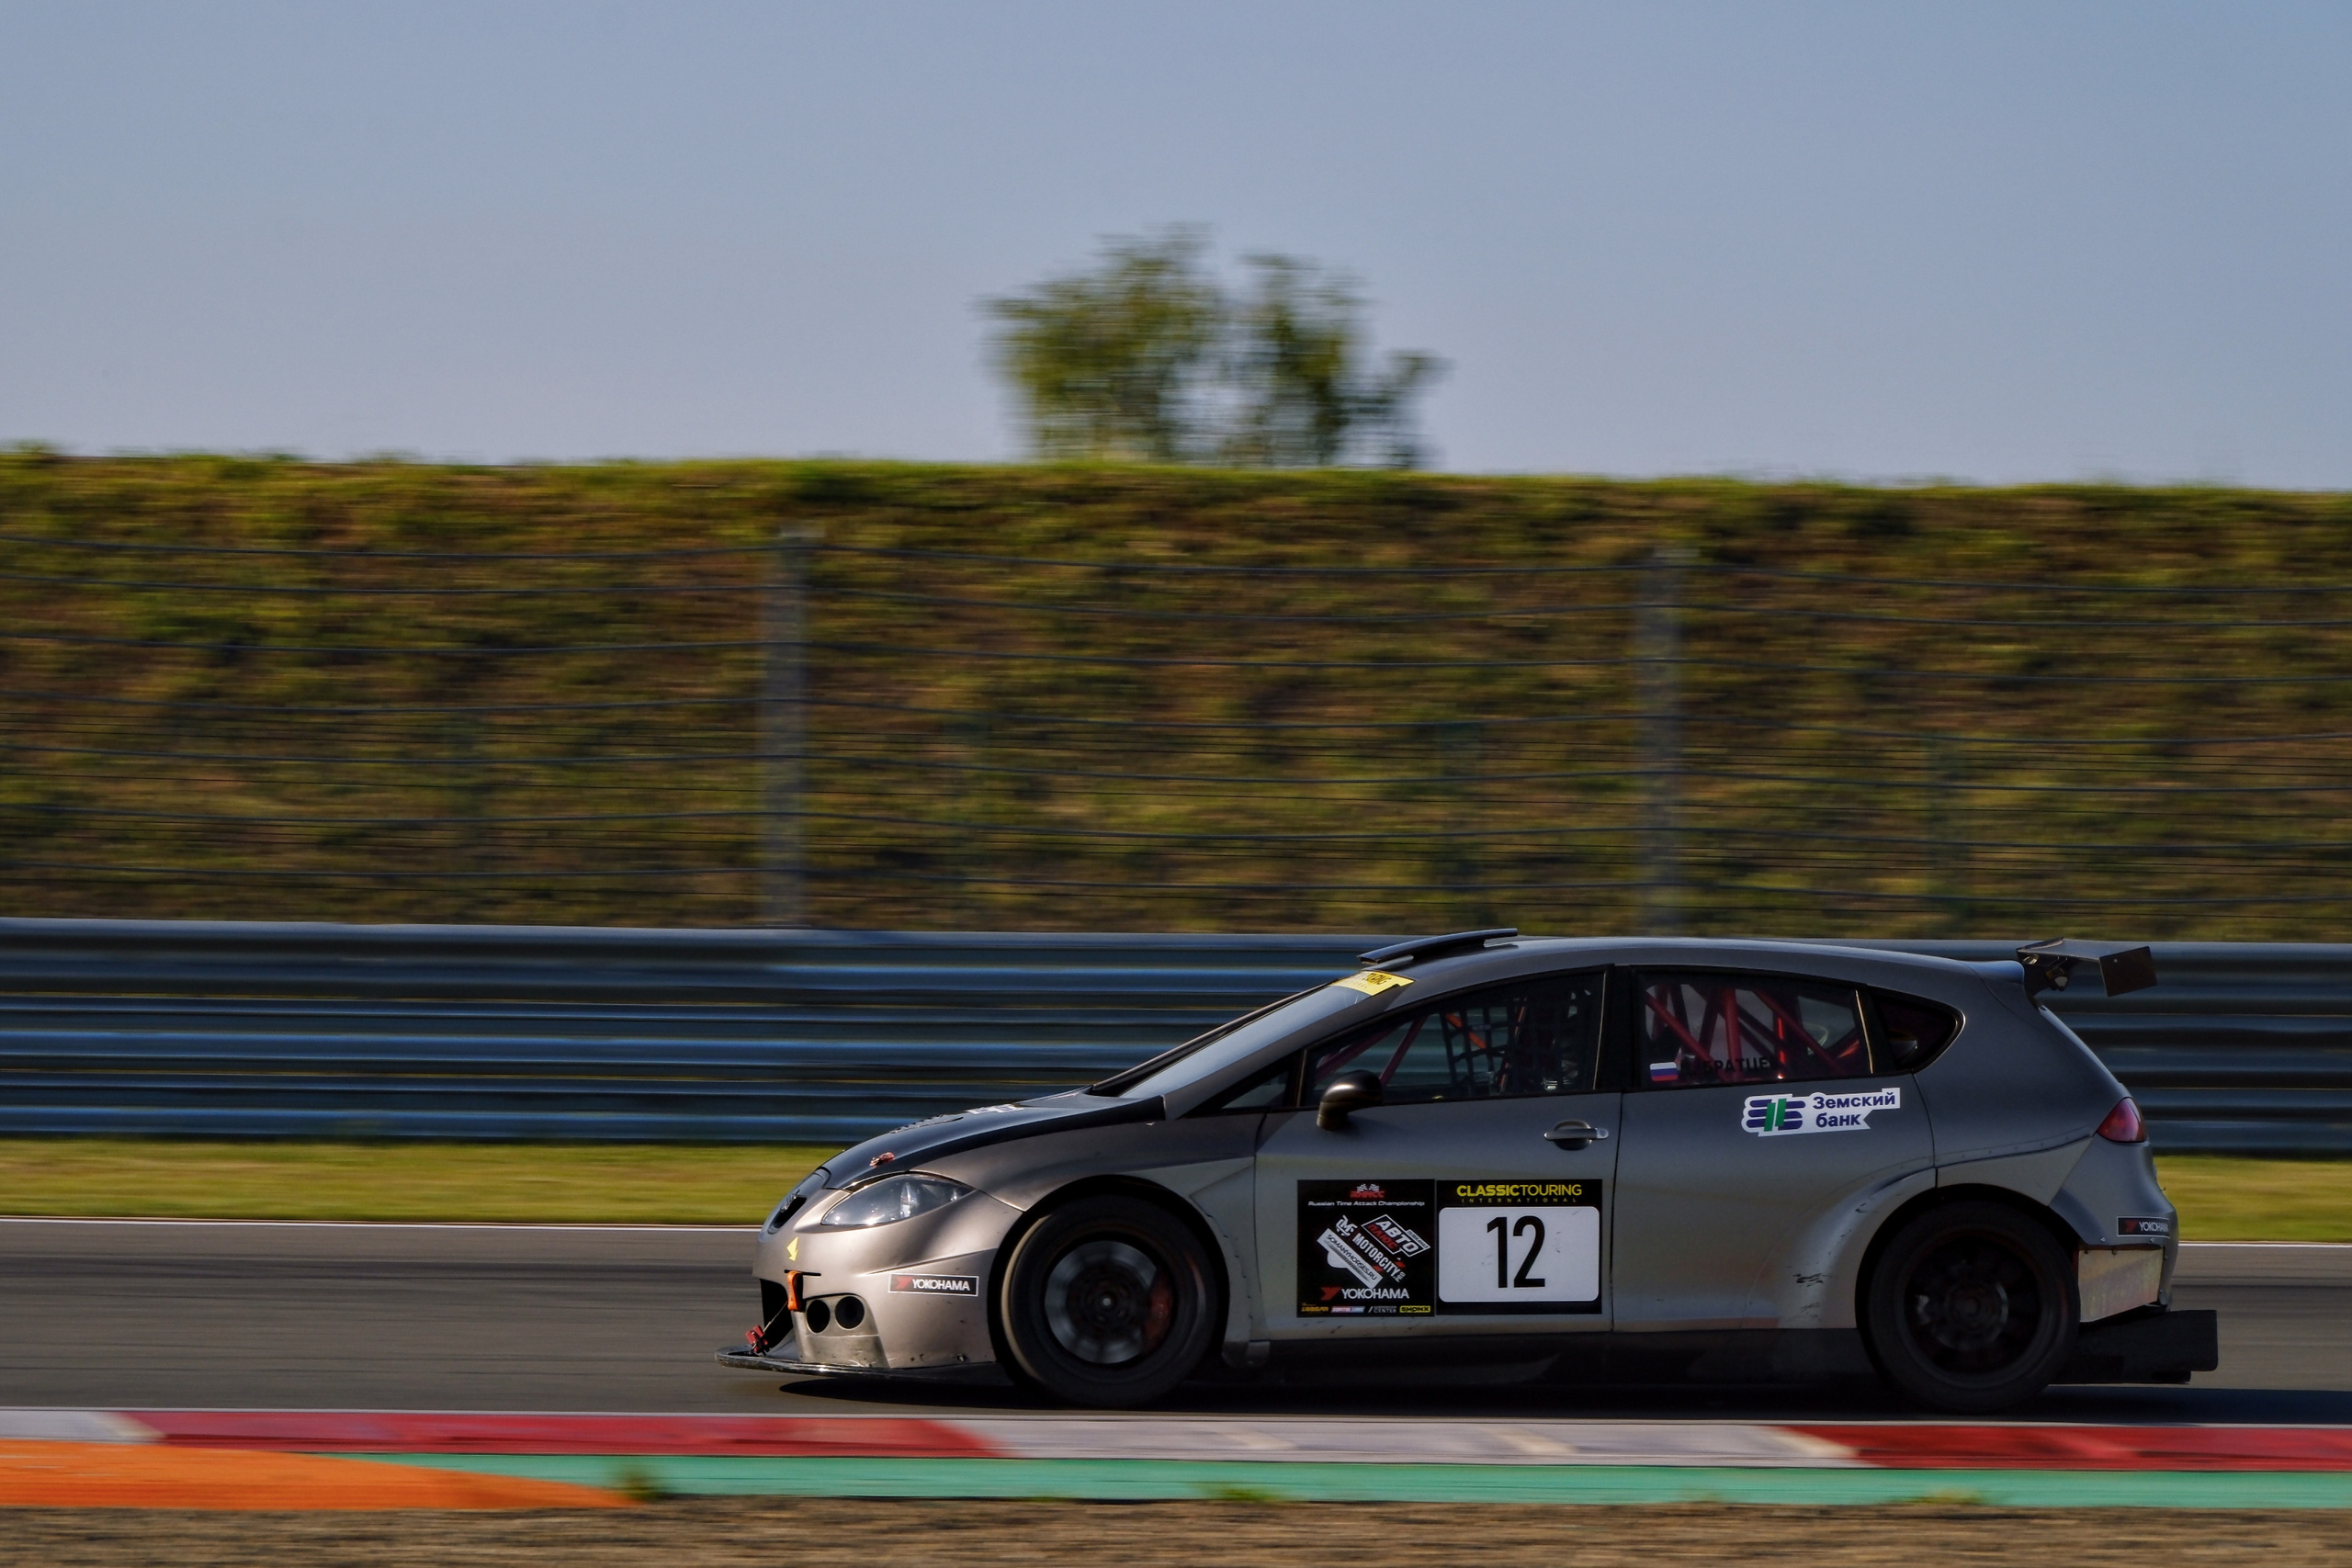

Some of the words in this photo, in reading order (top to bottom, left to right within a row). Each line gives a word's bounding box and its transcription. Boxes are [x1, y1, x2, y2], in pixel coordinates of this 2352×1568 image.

[1702, 1056, 1778, 1077] БРАТЦЕ
[1813, 1091, 1895, 1110] Земский
[1816, 1112, 1861, 1128] банк
[1456, 1184, 1582, 1197] CLASSICTOURING
[1375, 1221, 1419, 1253] АВТО
[1327, 1235, 1378, 1281] SOMANYHORSES.RU
[1487, 1215, 1545, 1289] 12
[912, 1279, 971, 1292] YOKOHAMA
[1341, 1288, 1410, 1300] YOKOHAMA
